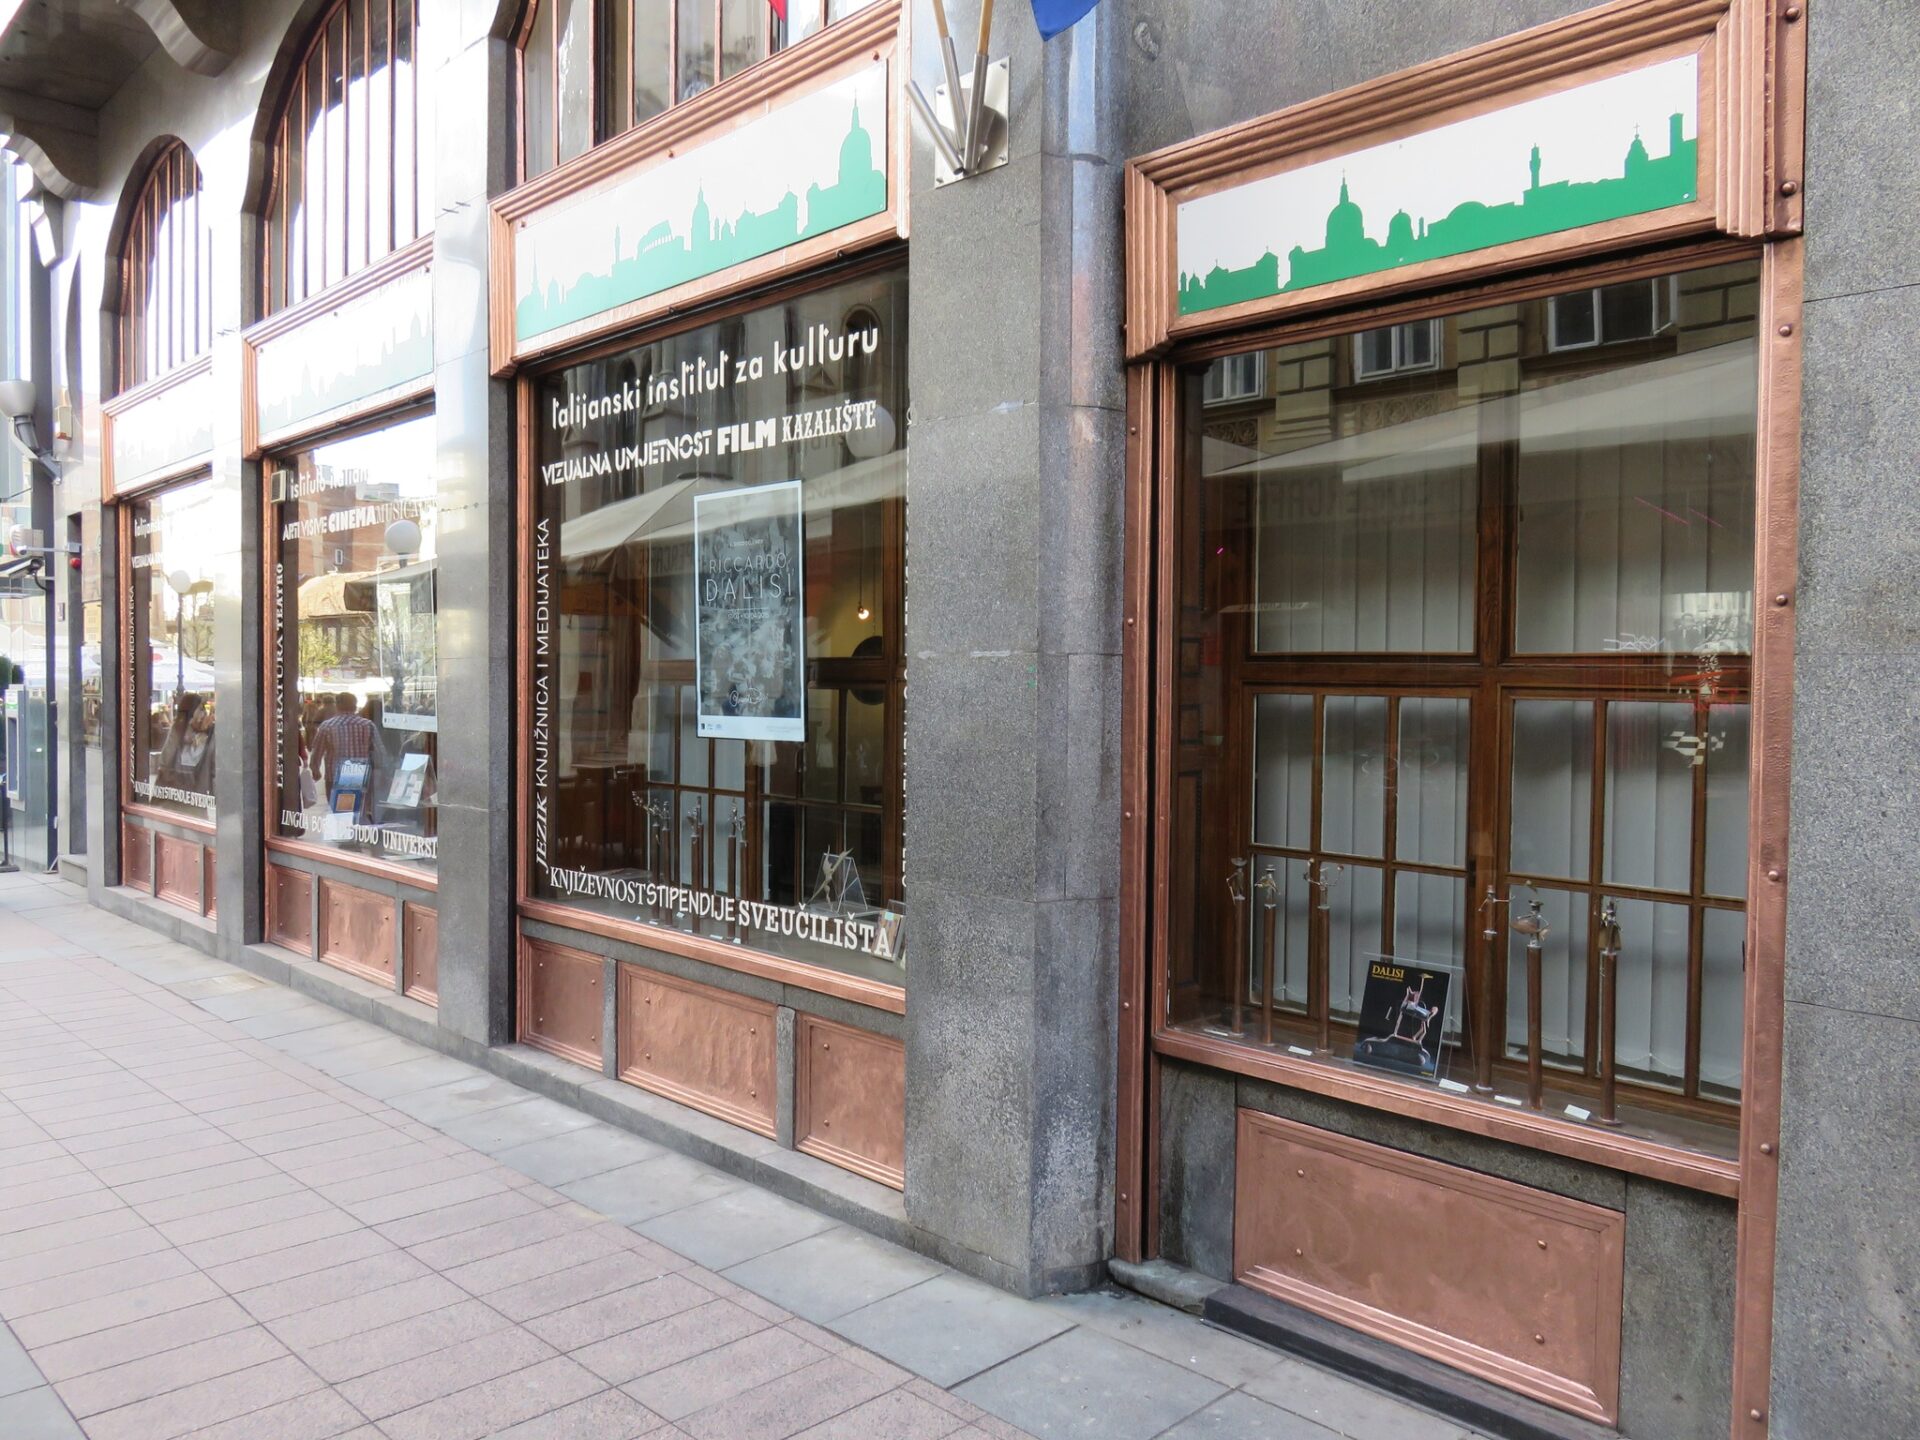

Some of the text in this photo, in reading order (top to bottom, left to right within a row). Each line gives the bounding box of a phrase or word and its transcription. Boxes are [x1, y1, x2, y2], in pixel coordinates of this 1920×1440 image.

[552, 322, 879, 431] talijanski institut za kulturu
[541, 398, 878, 487] VIZUALNA UMJETNOST FILM KAZALIŠTE
[328, 505, 376, 534] CINEMA
[276, 563, 285, 630] TEATRO
[536, 518, 550, 656] MEDIJATEKA
[706, 573, 792, 602] DALISI
[709, 552, 786, 574] RICCARDO
[533, 675, 549, 787] KNJIŽNICA
[281, 809, 308, 830] LINGUA
[535, 796, 549, 874] JEZIK
[550, 865, 893, 958] KNJIŽEVNOST STIPENDIJE SVEUČILIŠTA
[1371, 964, 1405, 979] DALISI
